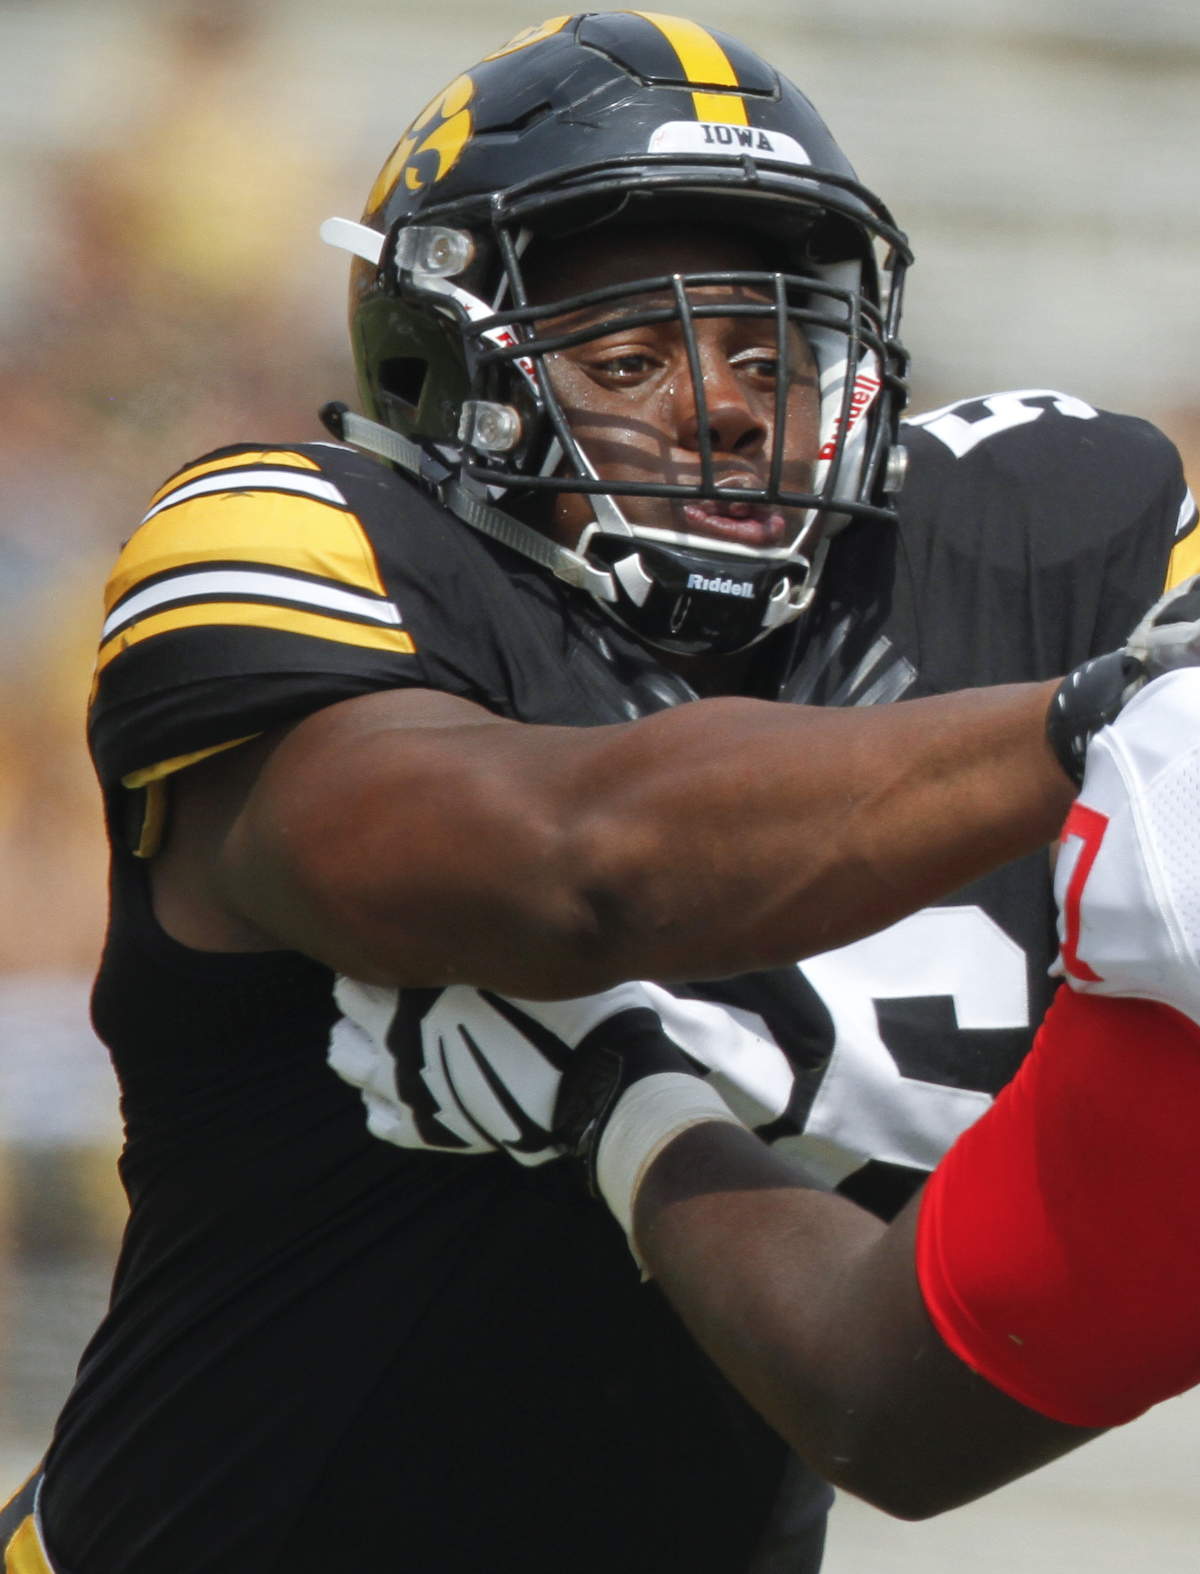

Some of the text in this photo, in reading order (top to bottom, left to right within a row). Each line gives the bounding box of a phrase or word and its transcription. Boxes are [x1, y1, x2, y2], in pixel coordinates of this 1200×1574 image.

[700, 124, 775, 153] IOWA
[818, 374, 882, 461] Rddell
[686, 573, 756, 599] Riddell
